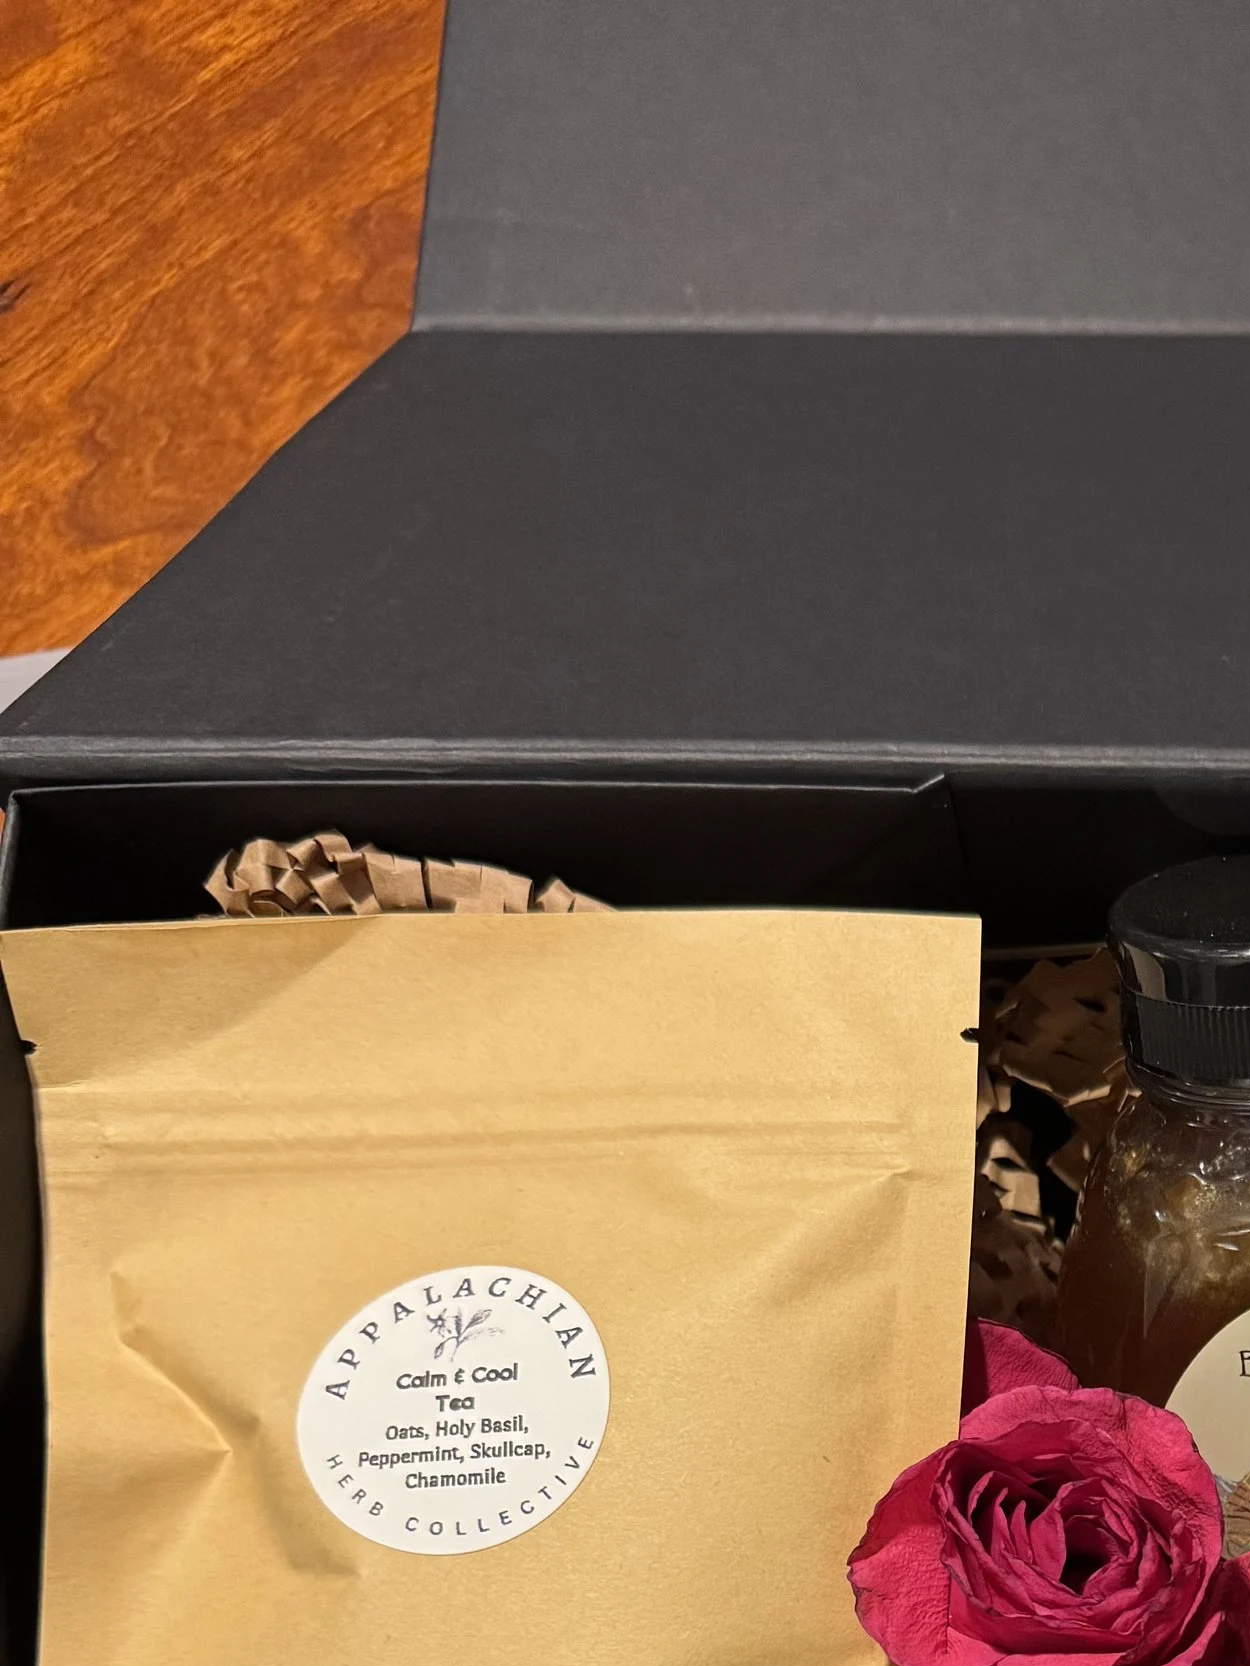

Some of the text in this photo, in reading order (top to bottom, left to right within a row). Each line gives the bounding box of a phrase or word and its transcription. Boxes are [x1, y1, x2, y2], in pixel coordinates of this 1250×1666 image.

[325, 1276, 597, 1400] APPALACHIAN
[396, 1363, 519, 1390] Calm & Cool
[435, 1394, 475, 1412] Tea
[385, 1415, 529, 1441] Oats, Holy Basil,
[358, 1441, 552, 1470] Peppermint, Skullcap,
[326, 1436, 594, 1536] HERB COLLECTIVE
[405, 1467, 506, 1489] Chamomile
